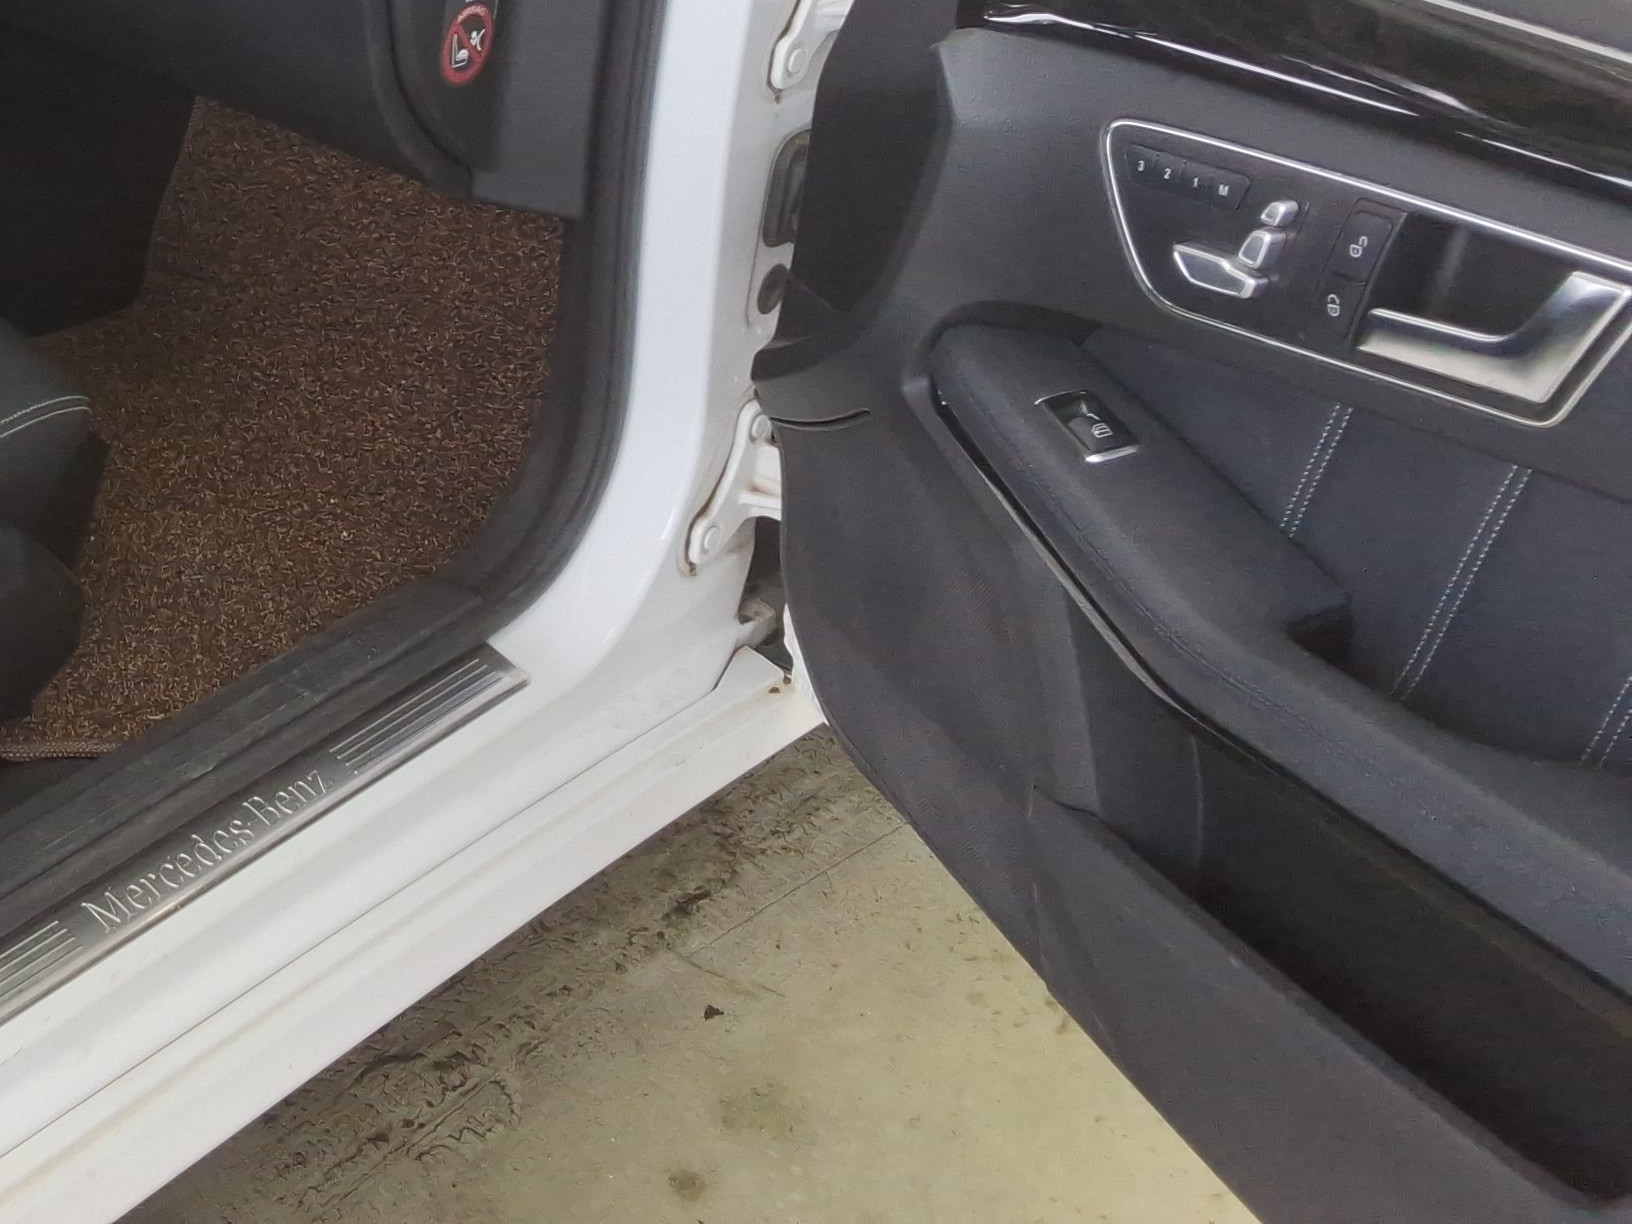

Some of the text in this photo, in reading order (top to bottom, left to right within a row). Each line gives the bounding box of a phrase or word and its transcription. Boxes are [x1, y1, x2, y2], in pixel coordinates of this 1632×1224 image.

[1137, 160, 1229, 196] 3 2 1 M
